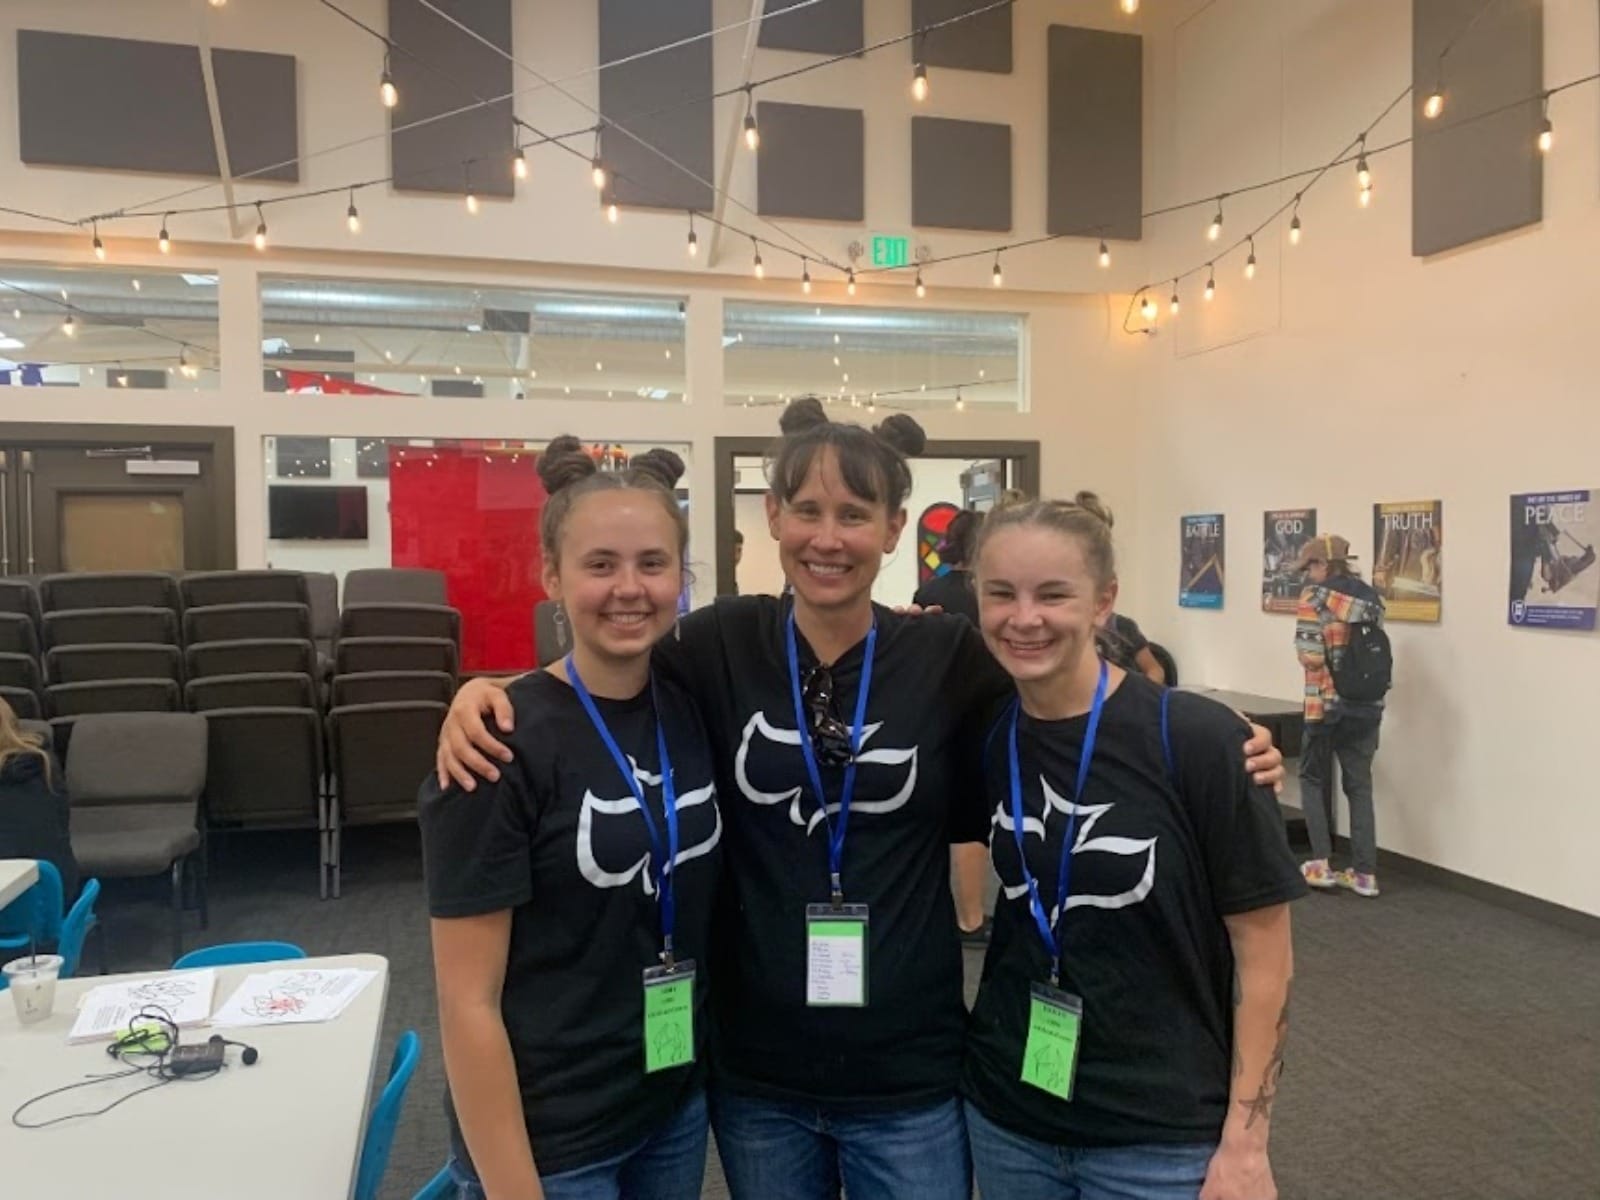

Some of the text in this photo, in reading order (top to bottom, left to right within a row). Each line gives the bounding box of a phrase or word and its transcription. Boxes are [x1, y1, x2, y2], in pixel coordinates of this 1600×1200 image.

[872, 236, 908, 266] EXIT
[1381, 511, 1433, 530] TRUTH
[1524, 503, 1585, 525] PEACE
[1275, 519, 1304, 535] GOD
